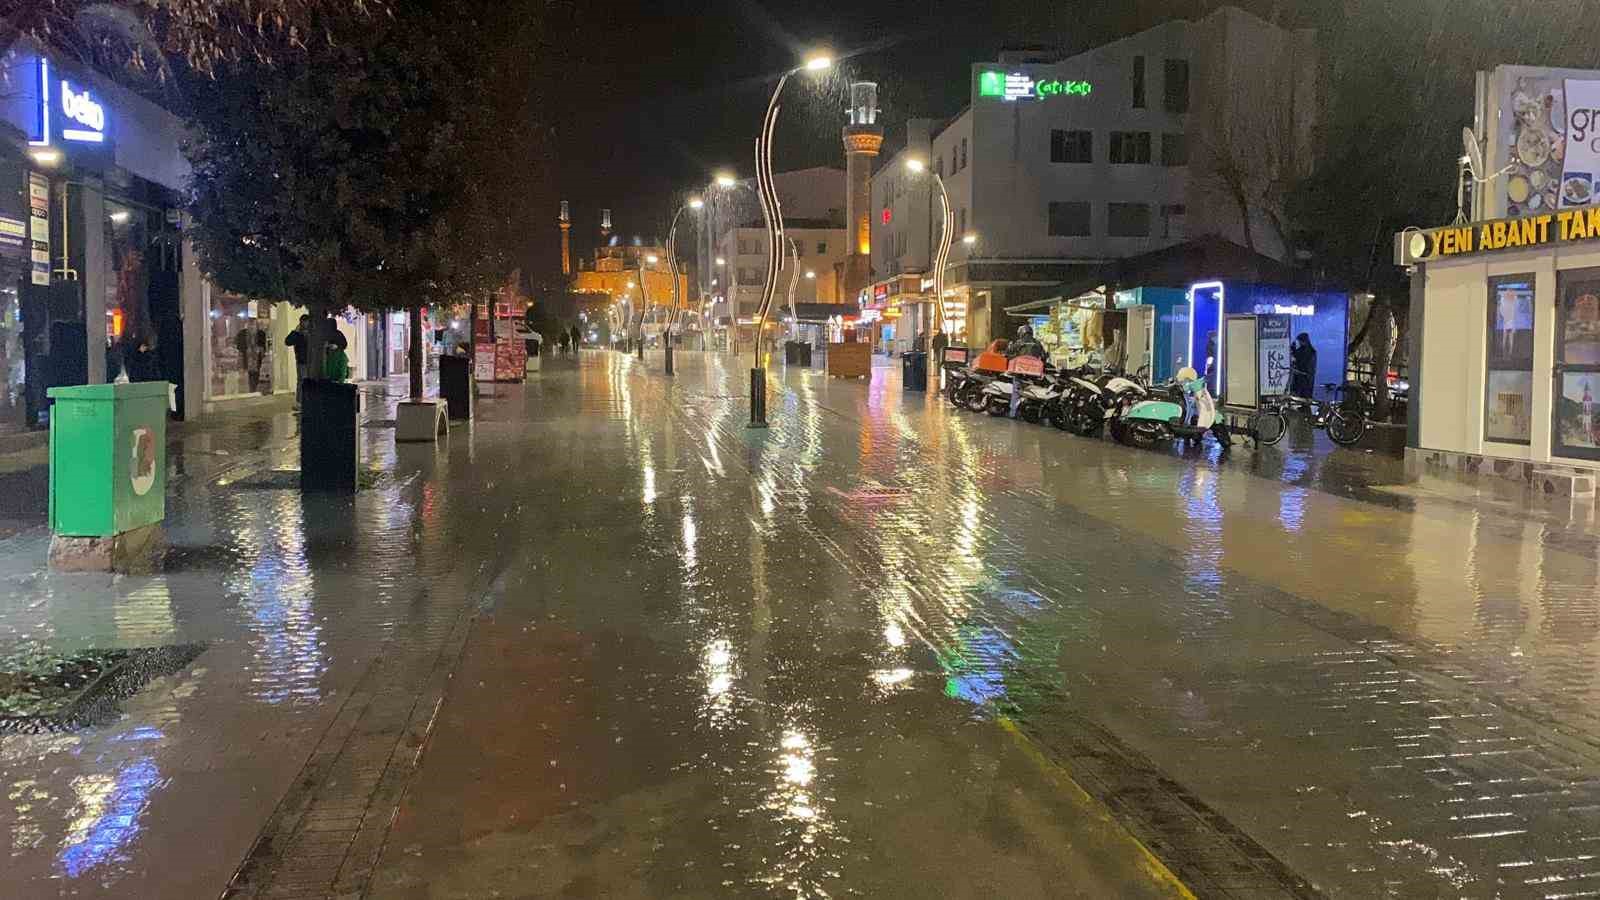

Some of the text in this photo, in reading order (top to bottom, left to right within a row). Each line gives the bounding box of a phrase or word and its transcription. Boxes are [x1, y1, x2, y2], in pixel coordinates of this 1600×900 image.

[62, 80, 104, 131] beko
[1480, 215, 1551, 250] ABANT
[1557, 207, 1600, 240] TAK
